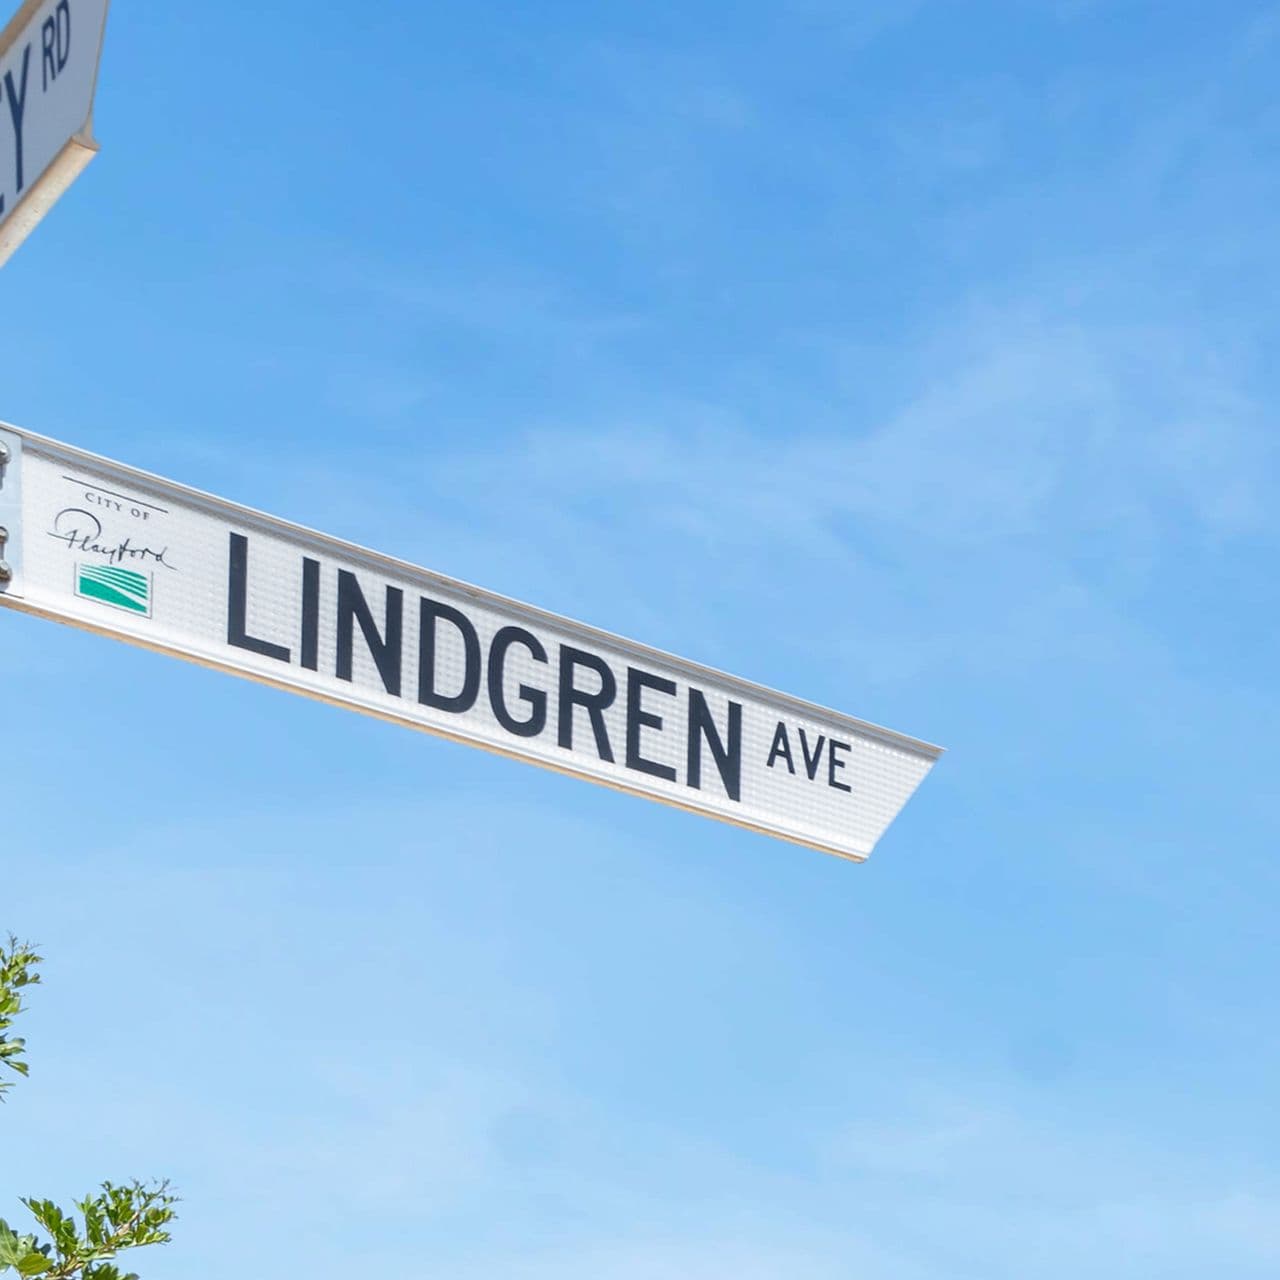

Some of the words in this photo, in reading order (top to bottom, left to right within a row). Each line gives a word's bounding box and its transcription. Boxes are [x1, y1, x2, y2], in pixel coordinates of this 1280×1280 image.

[0, 42, 31, 212] Y
[41, 0, 71, 93] RD
[46, 507, 178, 571] Playford
[84, 492, 122, 512] CITY
[130, 507, 150, 520] OF
[227, 531, 743, 804] LINDGREN
[766, 721, 852, 793] AVE
